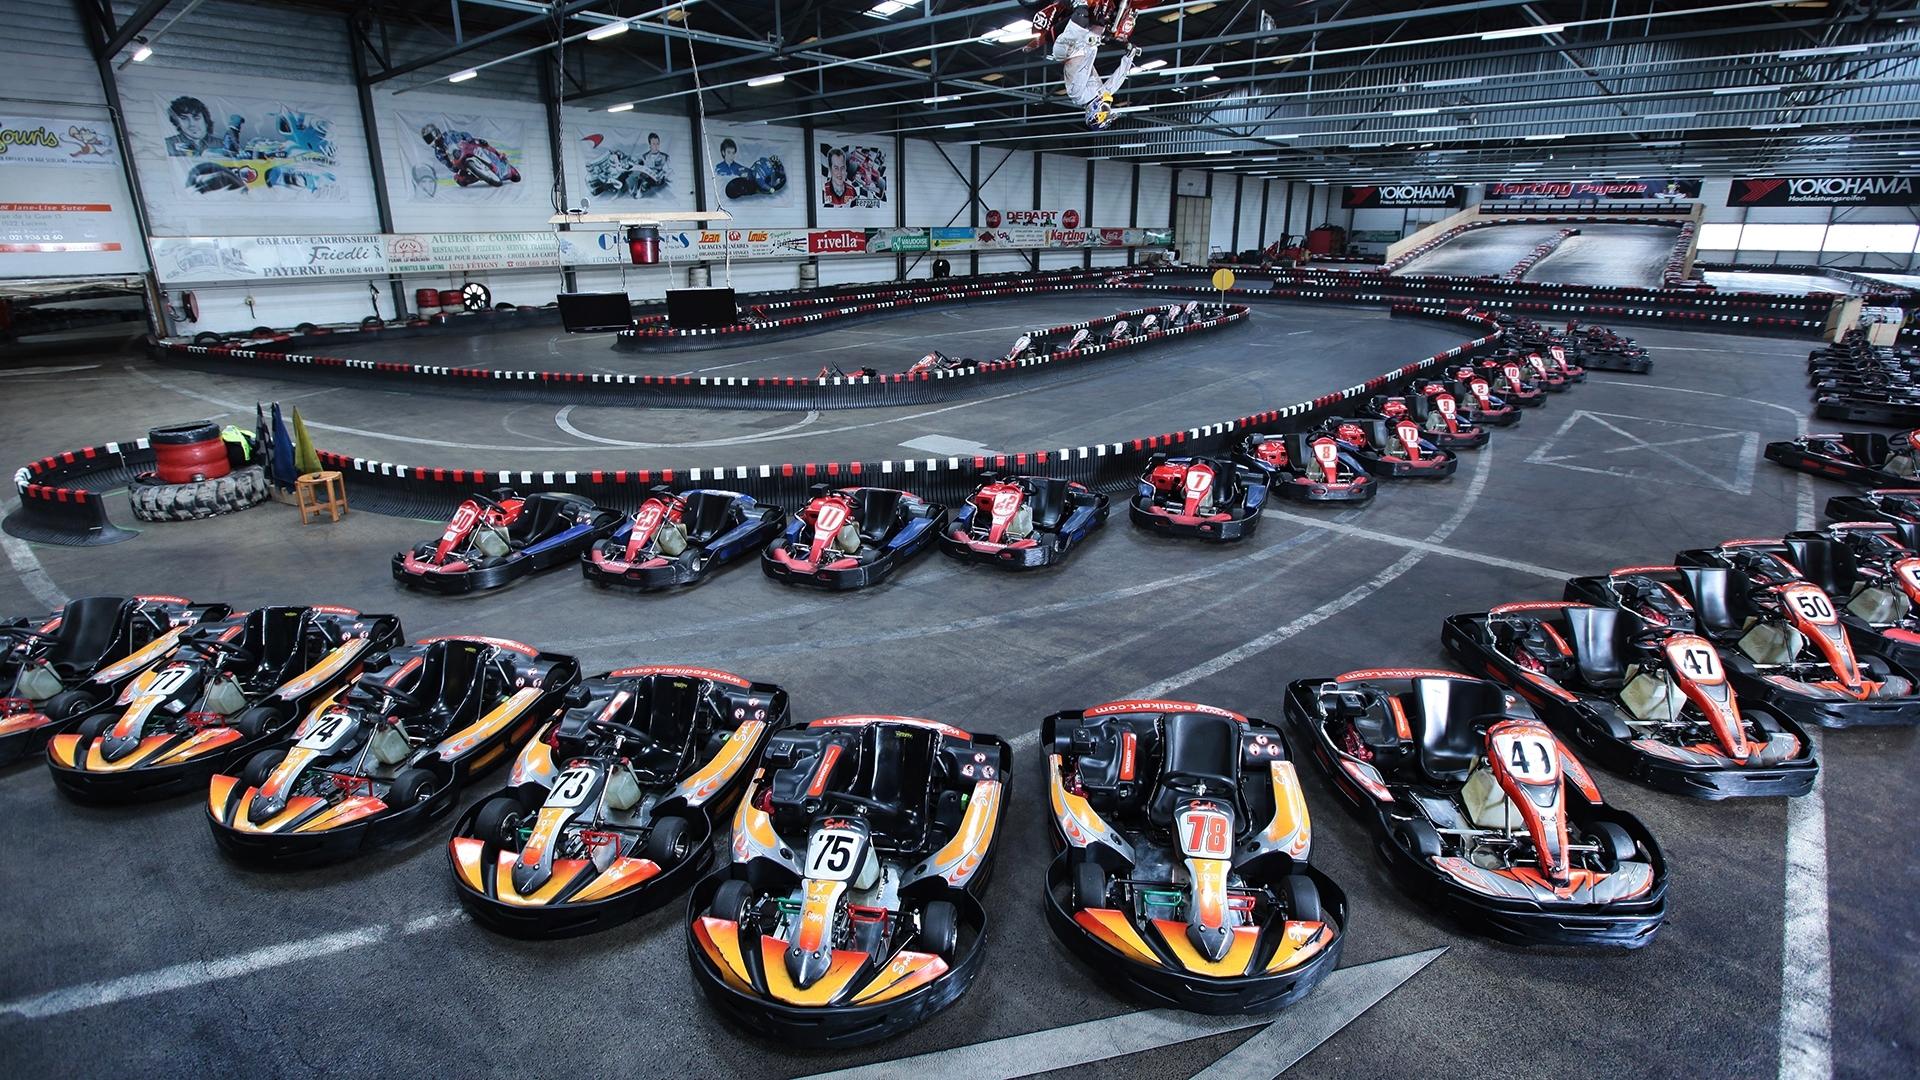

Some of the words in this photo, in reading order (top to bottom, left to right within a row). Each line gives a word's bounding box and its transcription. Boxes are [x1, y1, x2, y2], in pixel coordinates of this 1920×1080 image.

[0, 126, 60, 154] ouris
[1379, 186, 1456, 199] YOKOHAMA
[1492, 182, 1575, 197] Karting
[1577, 184, 1648, 196] Payerne
[1788, 178, 1913, 195] YOKOHAMA
[1788, 195, 1866, 203] Hochleistungsreifen
[1007, 211, 1058, 220] DEPART
[256, 236, 303, 246] GARAGE
[310, 235, 380, 245] CARROSSERIE
[432, 233, 486, 244] AUBERGE
[489, 232, 557, 242] COMMUNALE
[698, 230, 721, 243] Jean
[747, 231, 769, 242] Louis
[817, 233, 858, 249] rivella
[901, 237, 928, 245] VAUDOISE
[1051, 229, 1085, 243] Karting
[308, 245, 370, 265] Friedli
[263, 266, 327, 277] PAYERNE
[1402, 429, 1415, 441] 17
[1194, 474, 1206, 489] 7
[1797, 594, 1831, 618] 50
[1683, 648, 1713, 675] 47
[148, 670, 186, 692] 77
[622, 667, 741, 684] www.sodikart.com
[1095, 702, 1234, 718] www.sodikart.com
[305, 716, 343, 743] 74
[549, 770, 590, 800] 73
[1187, 814, 1228, 854] 78
[813, 834, 854, 872] 75
